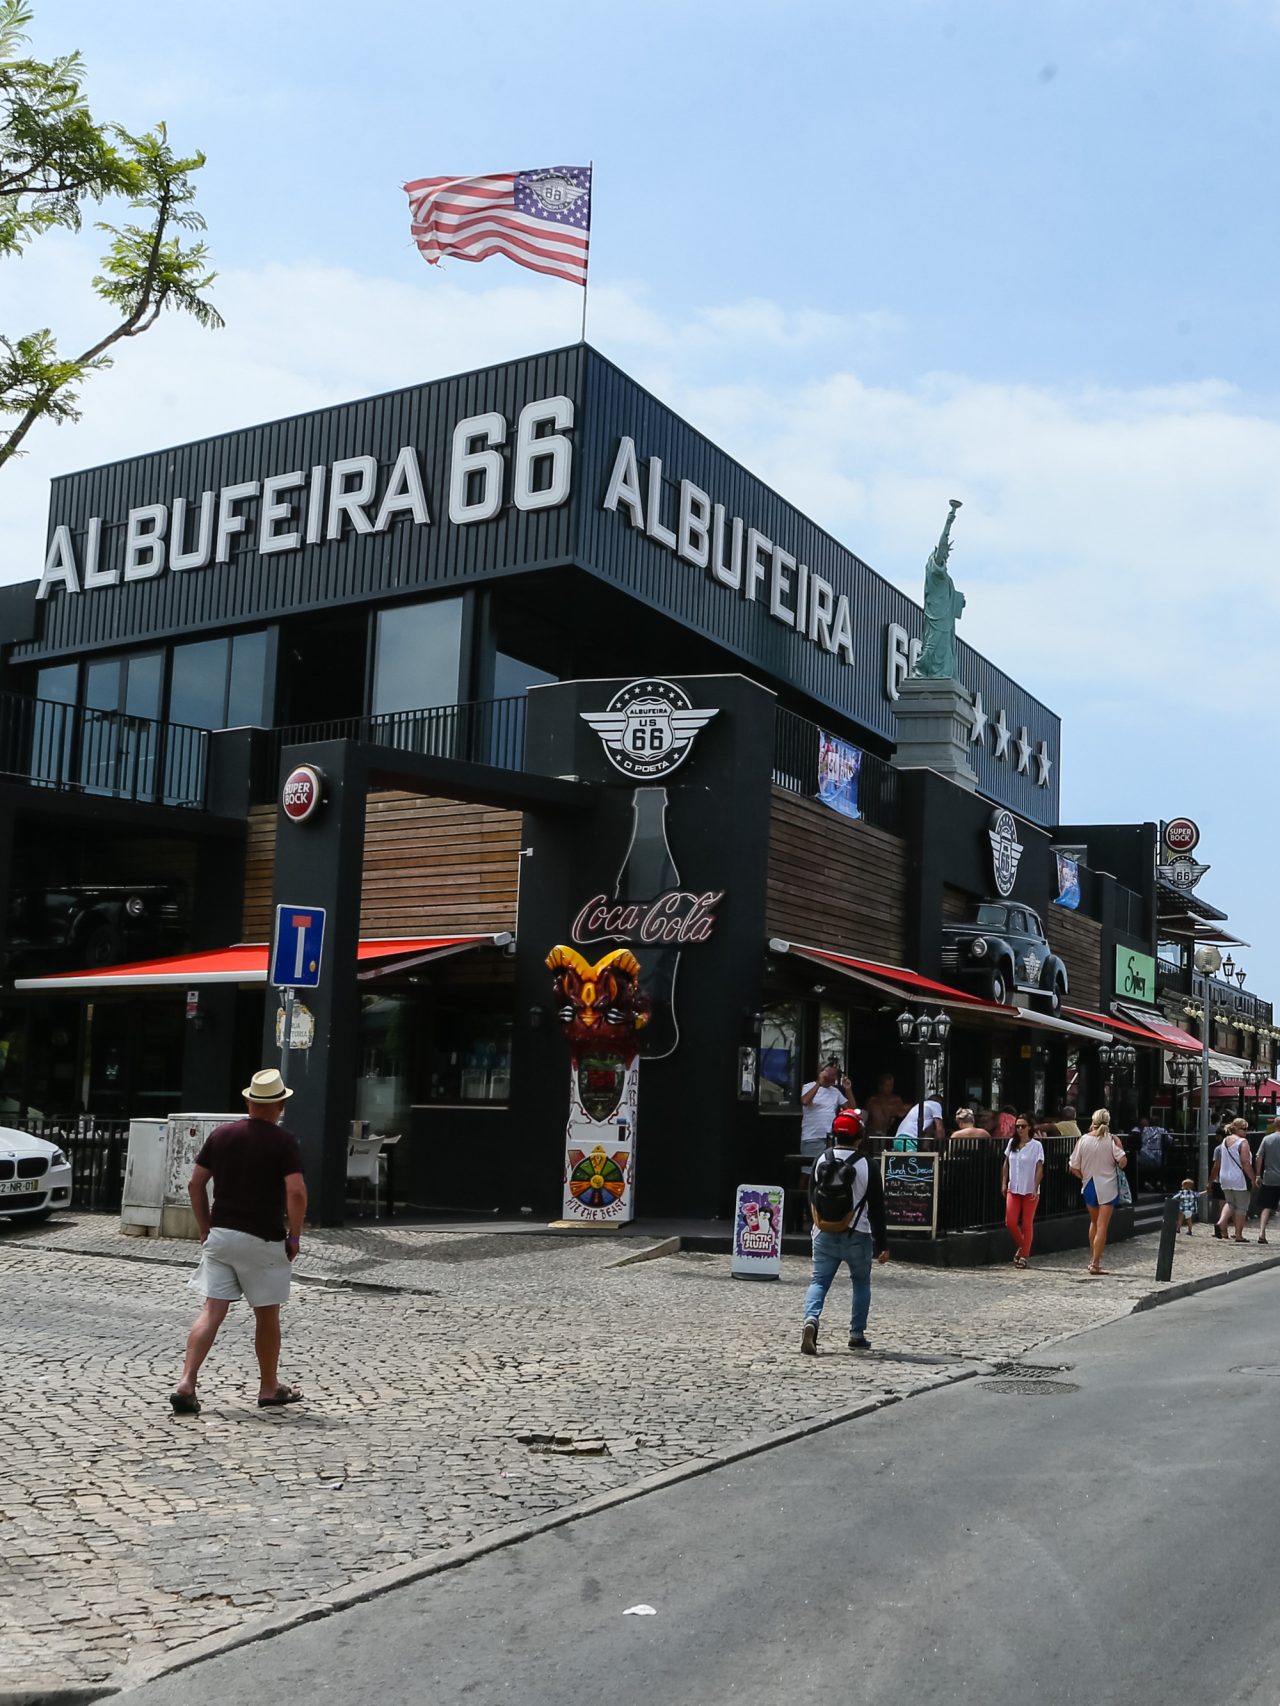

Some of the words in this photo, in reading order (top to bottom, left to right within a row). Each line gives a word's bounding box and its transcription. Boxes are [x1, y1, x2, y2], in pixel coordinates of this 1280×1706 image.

[35, 446, 431, 600] ALBUFEIRA
[448, 395, 574, 525] 66
[603, 435, 855, 666] ALBUFEIRA
[639, 719, 657, 727] US
[632, 728, 664, 751] 66
[634, 760, 670, 773] POETA
[284, 782, 310, 795] SUPER
[284, 793, 308, 806] BOCK
[1169, 828, 1192, 836] SUPER
[1170, 834, 1190, 842] BOCK
[1176, 871, 1190, 881] 66
[572, 892, 725, 944] Coca-Cola
[743, 1232, 772, 1242] ARCTIC
[744, 1240, 769, 1249] SLUSH
